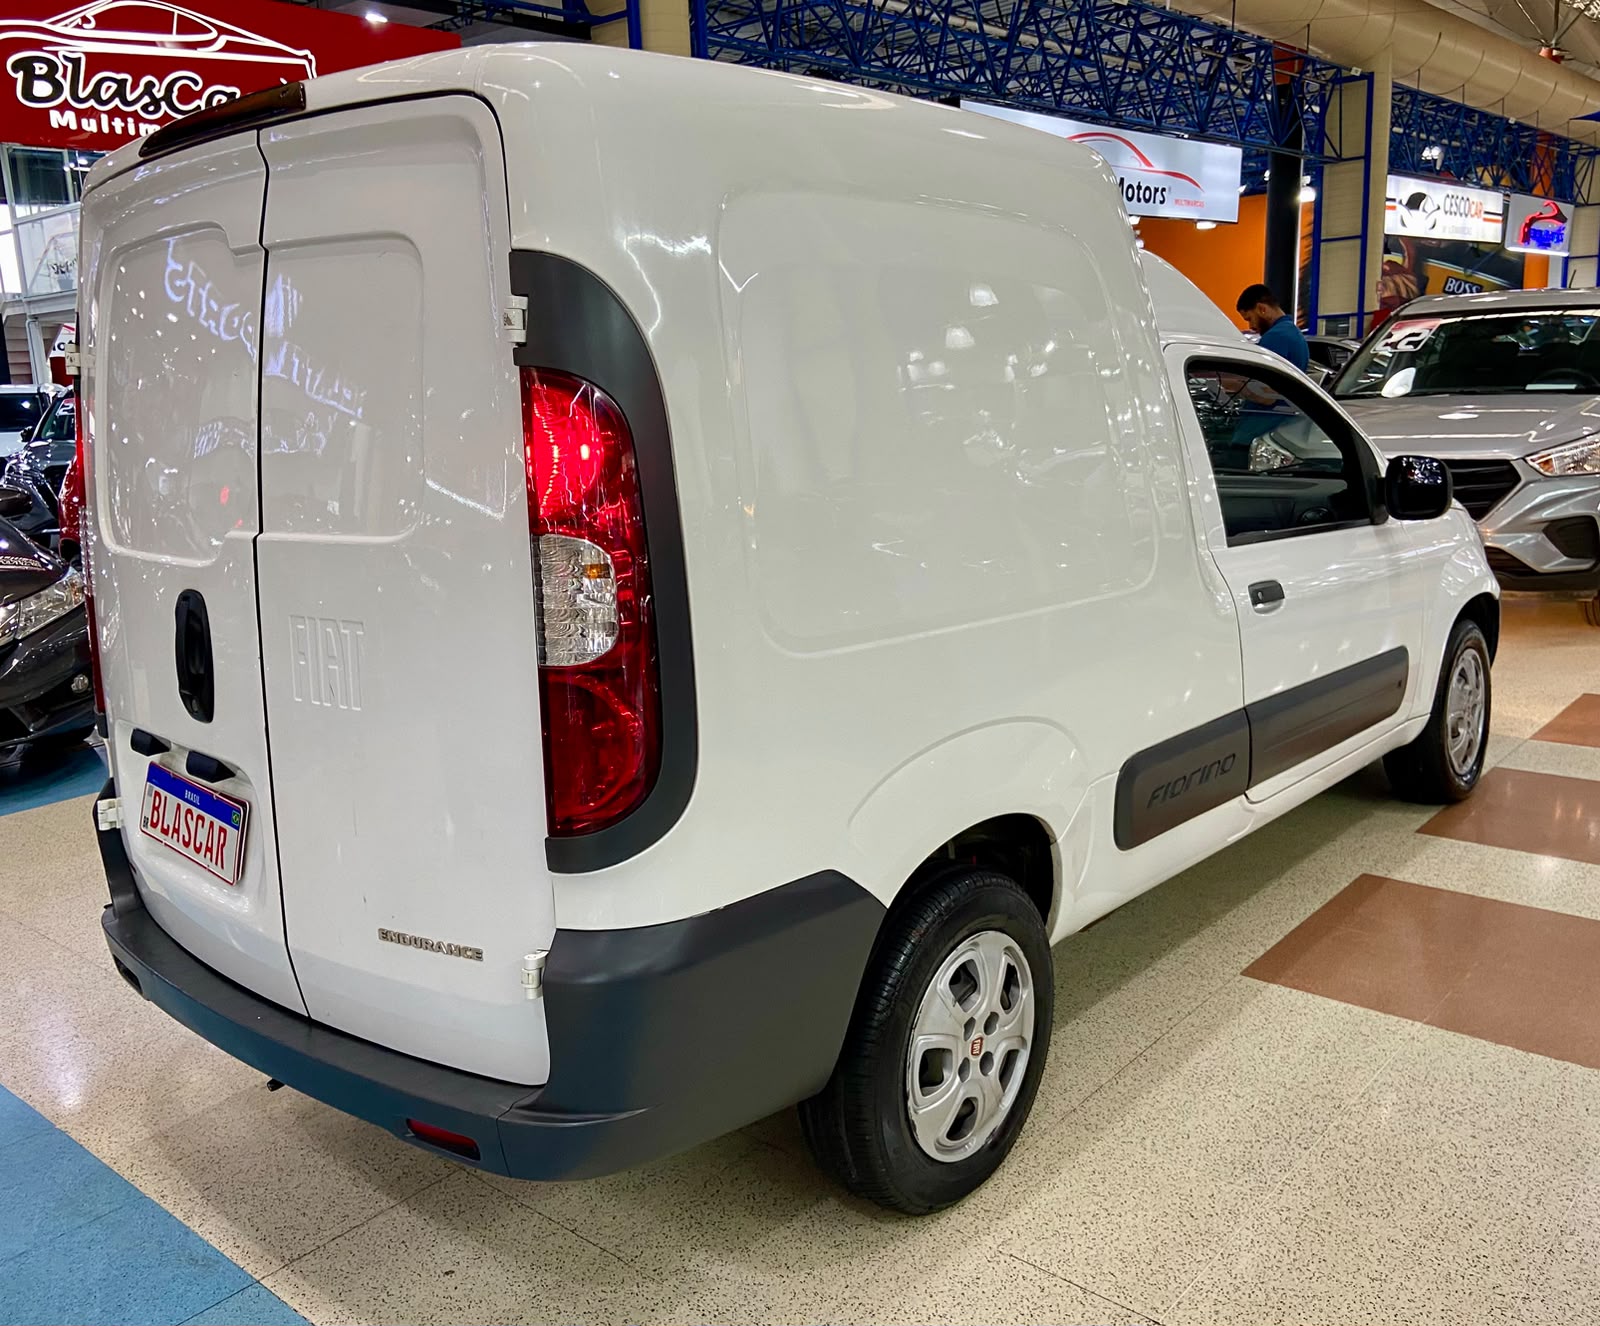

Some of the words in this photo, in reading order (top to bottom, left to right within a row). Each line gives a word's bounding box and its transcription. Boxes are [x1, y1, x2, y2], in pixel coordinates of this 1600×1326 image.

[1443, 193, 1484, 219] CESCOCAR
[1445, 277, 1481, 294] BOSS
[289, 614, 365, 712] FIAT
[184, 789, 201, 806] BRASIL
[149, 790, 228, 870] BLASCAR
[377, 928, 484, 962] ENDURANCE
